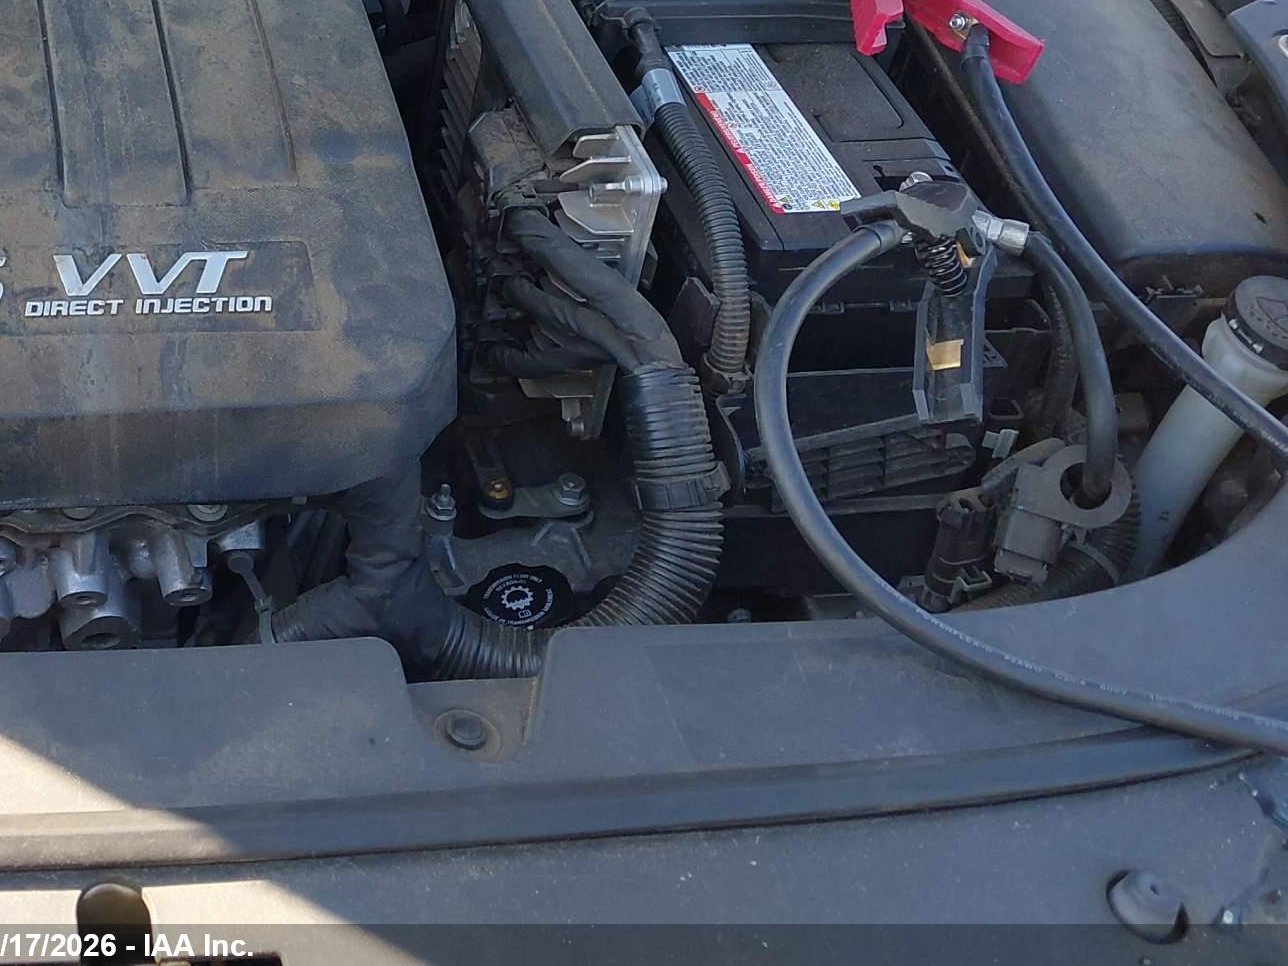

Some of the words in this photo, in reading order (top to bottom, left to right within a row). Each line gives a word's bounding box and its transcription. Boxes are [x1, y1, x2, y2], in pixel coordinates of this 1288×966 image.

[53, 250, 249, 297] VVT
[25, 298, 123, 317] DIRECT
[135, 296, 273, 315] INJECTION
